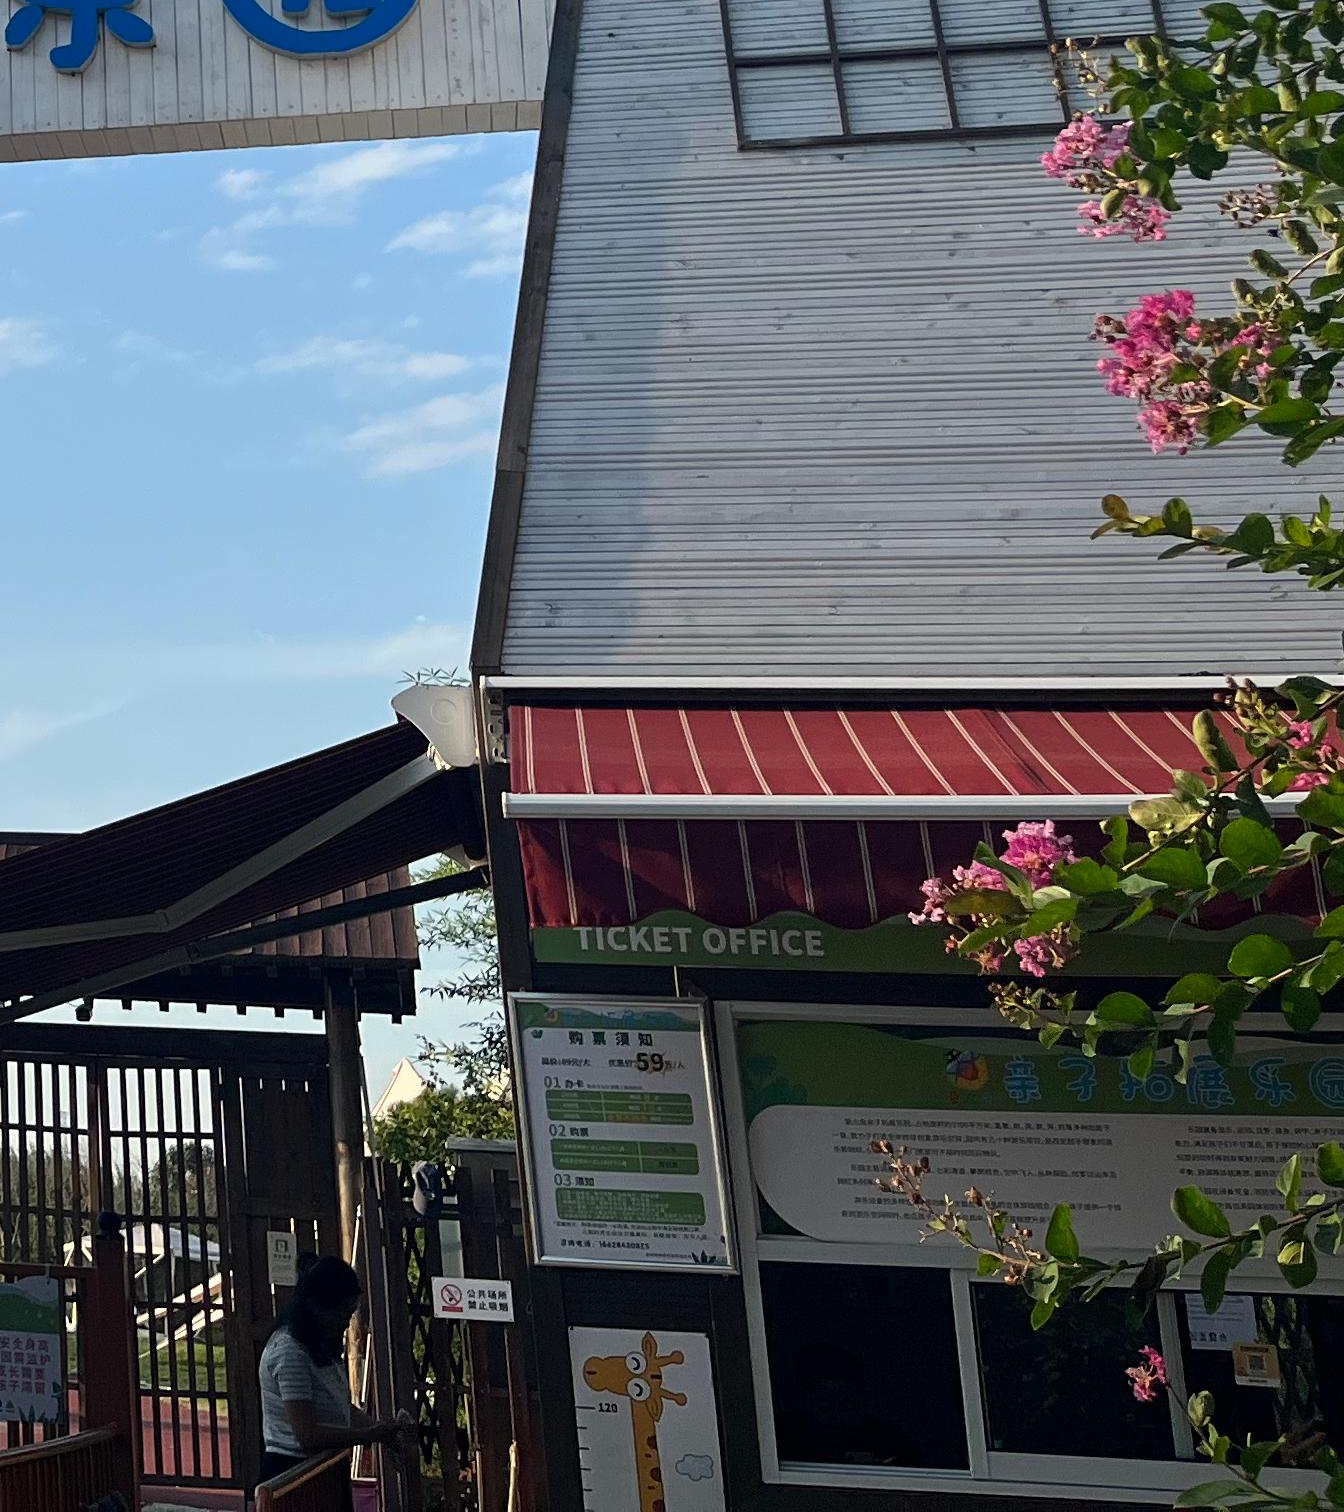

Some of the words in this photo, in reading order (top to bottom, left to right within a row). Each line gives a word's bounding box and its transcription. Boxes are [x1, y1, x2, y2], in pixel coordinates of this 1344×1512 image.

[573, 926, 691, 954] TICKET
[702, 928, 825, 957] OFFICE
[569, 1031, 653, 1047] 购票须知
[544, 1076, 561, 1088] 01
[549, 1124, 566, 1137] 02
[554, 1174, 571, 1186] 03
[467, 1289, 507, 1300] 公共场所
[468, 1300, 509, 1312] 禁止吸烟
[598, 1402, 618, 1413] 120
